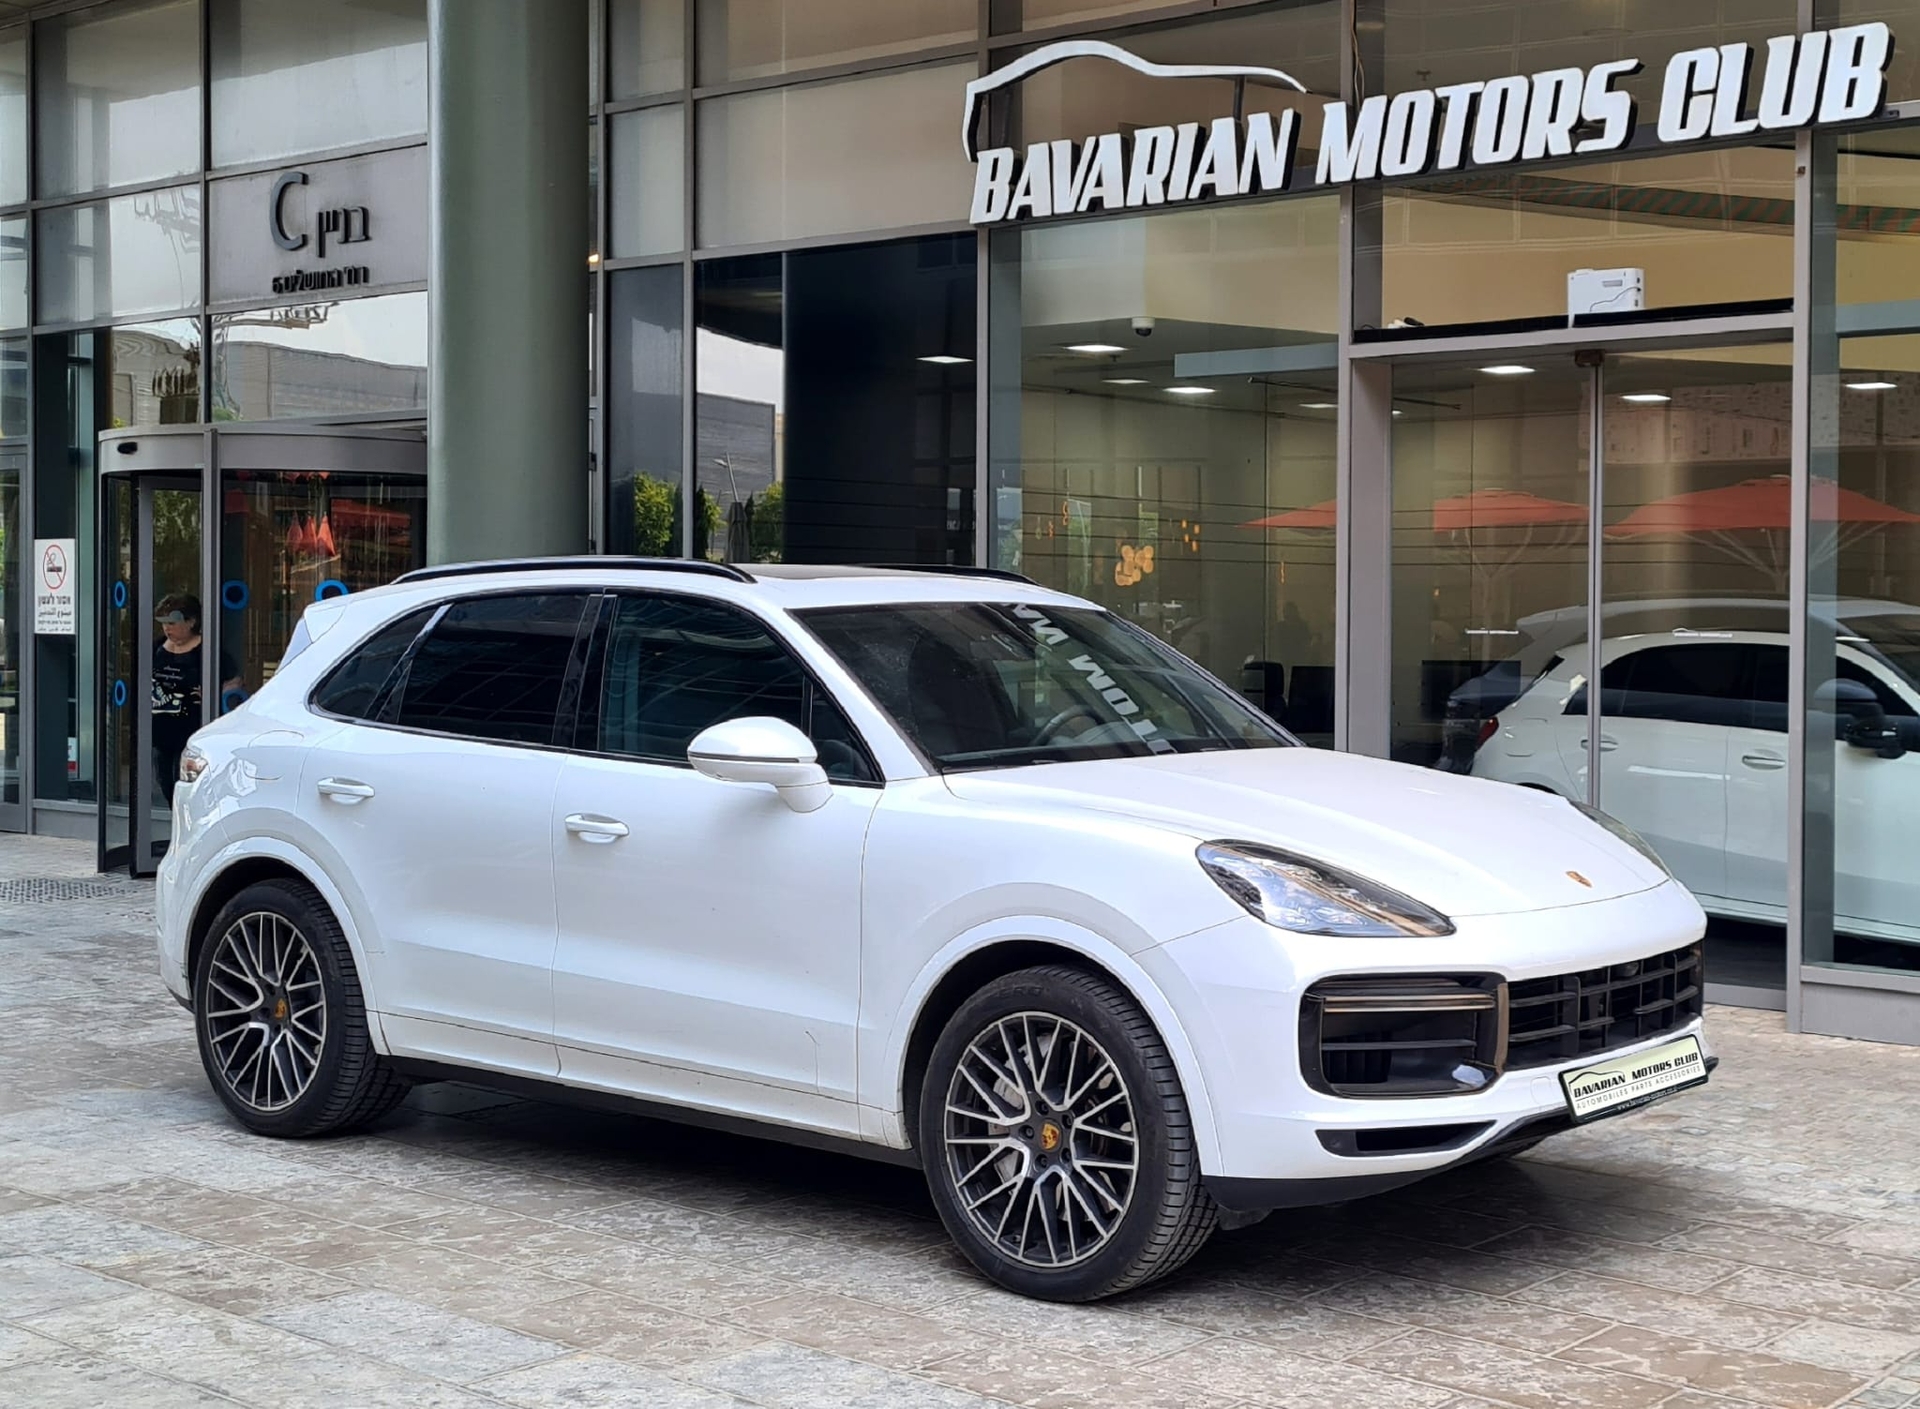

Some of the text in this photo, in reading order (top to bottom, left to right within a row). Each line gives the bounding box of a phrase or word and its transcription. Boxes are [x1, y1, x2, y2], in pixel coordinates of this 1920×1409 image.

[969, 21, 1891, 226] BAVARIAN MOTORS CLUB
[270, 171, 372, 258] בניין C
[1573, 1075, 1626, 1098] BAVARIAN
[1631, 1060, 1672, 1080] MOTORS
[1673, 1052, 1699, 1068] CLUB
[1576, 1088, 1628, 1109] AUTOMOBILES
[1631, 1080, 1653, 1092] PARTS
[1655, 1065, 1701, 1085] ACCESSORIES
